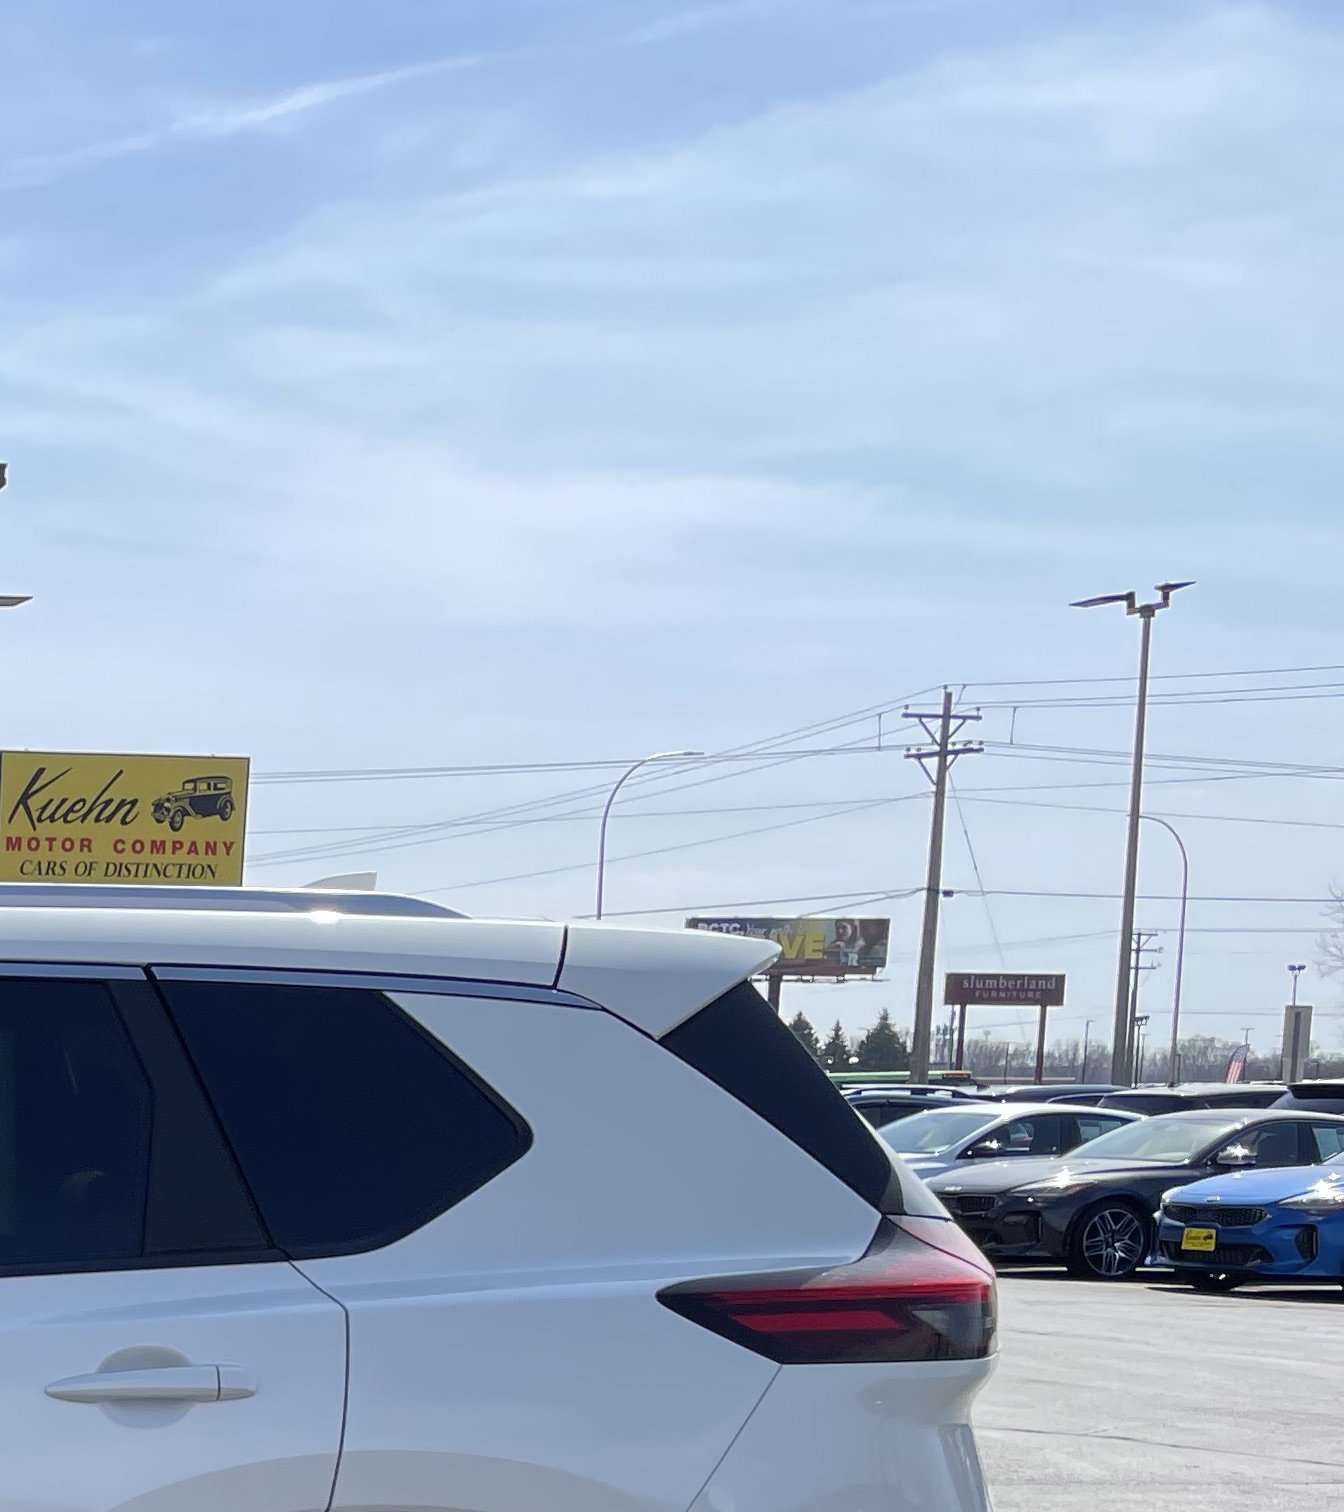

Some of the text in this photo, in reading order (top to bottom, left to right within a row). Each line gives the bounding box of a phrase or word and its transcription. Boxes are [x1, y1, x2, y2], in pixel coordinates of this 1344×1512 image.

[8, 767, 140, 832] Kuehn
[5, 836, 236, 857] MOTOR COMPANY
[19, 859, 218, 880] CARS OF DISTINCTION
[962, 975, 1056, 990] slumberland
[974, 989, 1043, 1000] FURNITURE
